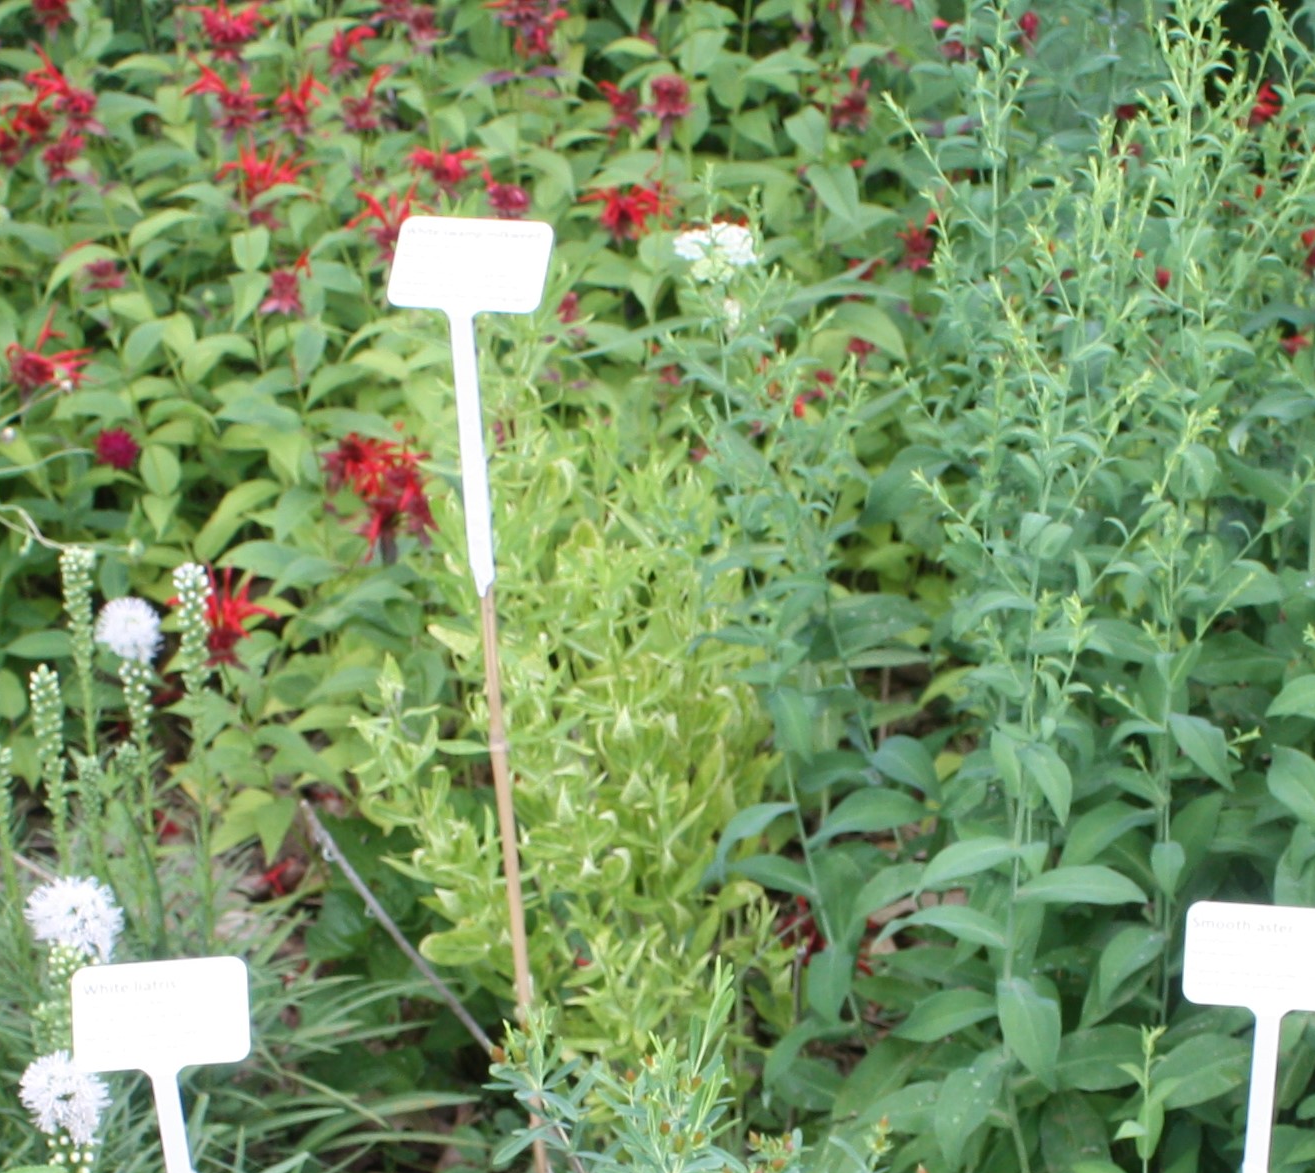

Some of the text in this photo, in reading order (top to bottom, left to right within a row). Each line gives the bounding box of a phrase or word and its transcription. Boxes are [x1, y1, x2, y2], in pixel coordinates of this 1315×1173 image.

[1191, 916, 1294, 935] Smooth aster
[82, 982, 129, 996] White
